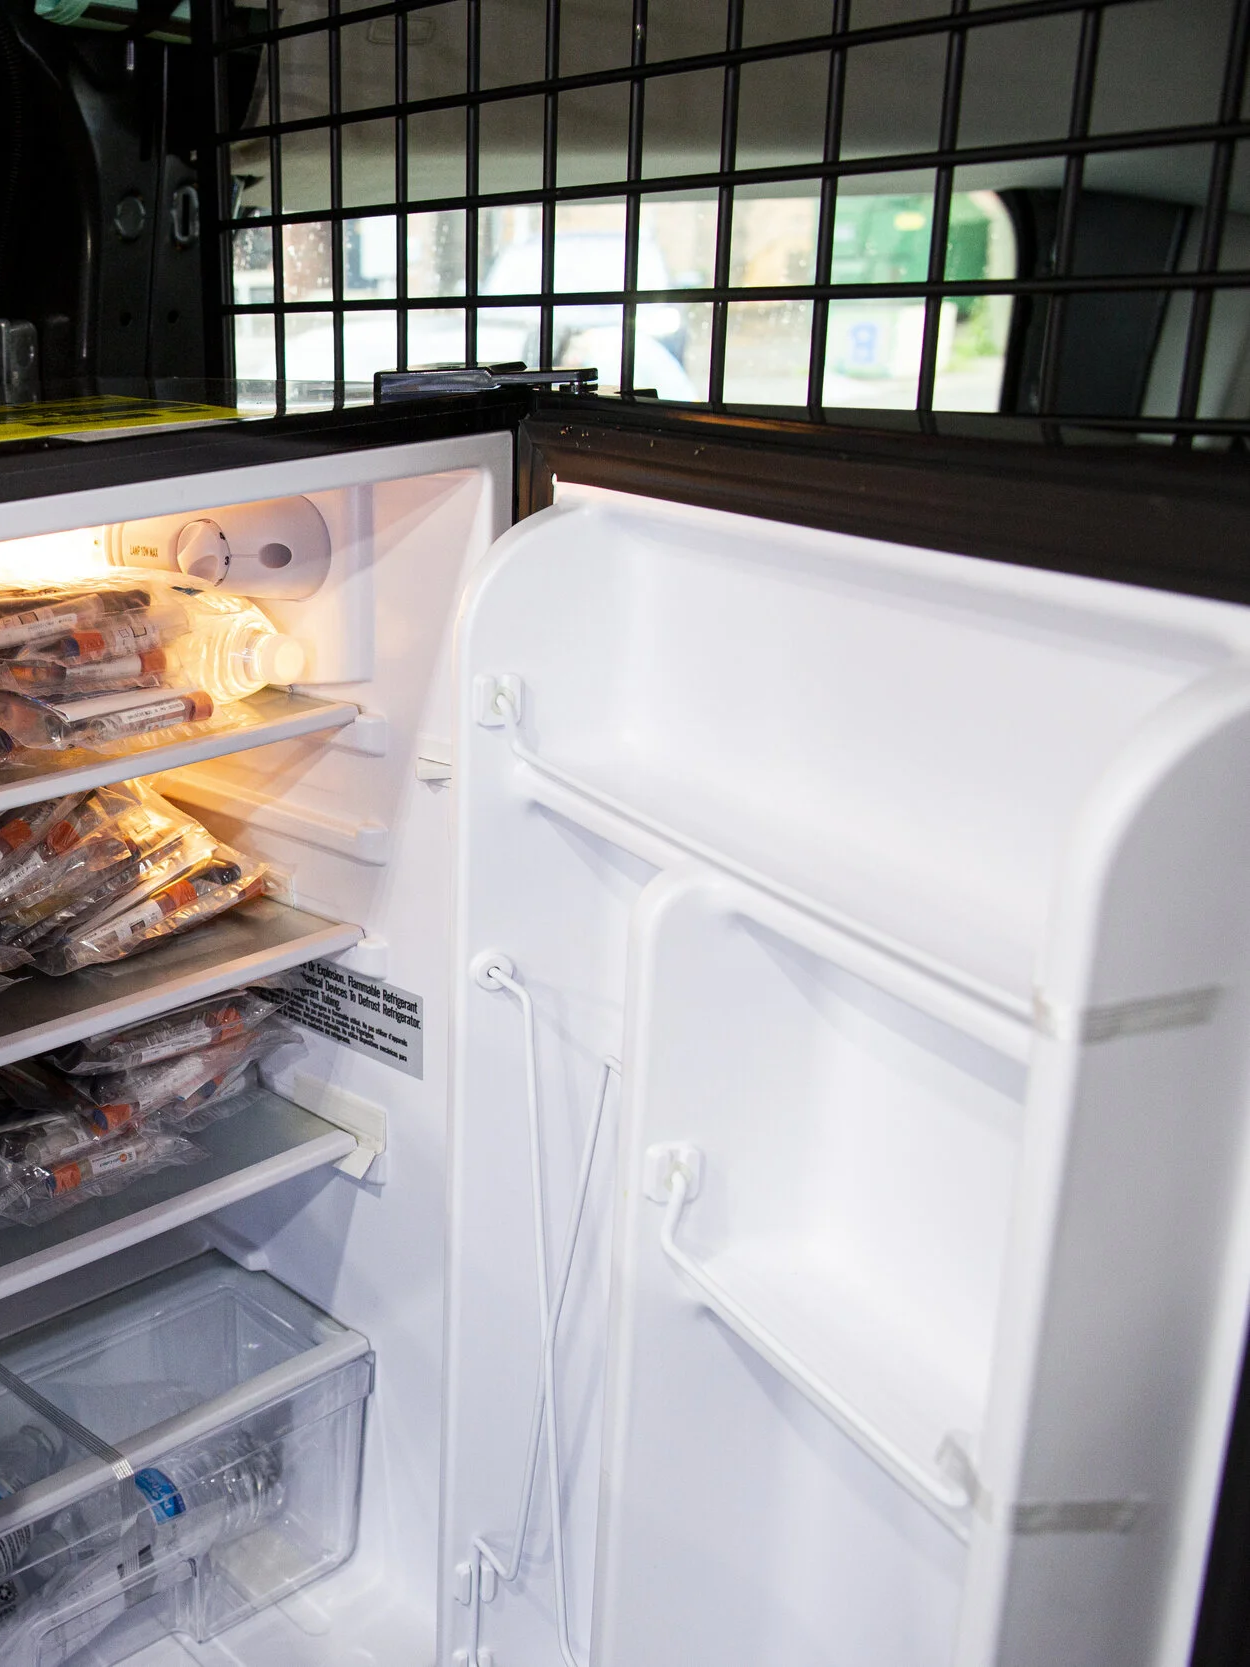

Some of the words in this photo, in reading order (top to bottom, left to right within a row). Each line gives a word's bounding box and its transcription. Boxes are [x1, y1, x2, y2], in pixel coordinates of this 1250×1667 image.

[224, 555, 230, 566] 3
[316, 963, 345, 985] Explosion.
[347, 974, 380, 999] Flammable
[382, 988, 417, 1014] Refrigerant
[325, 979, 347, 999] Devices
[349, 989, 356, 1003] To
[357, 992, 380, 1013] Defrost
[382, 1002, 421, 1030] Refrigerator.
